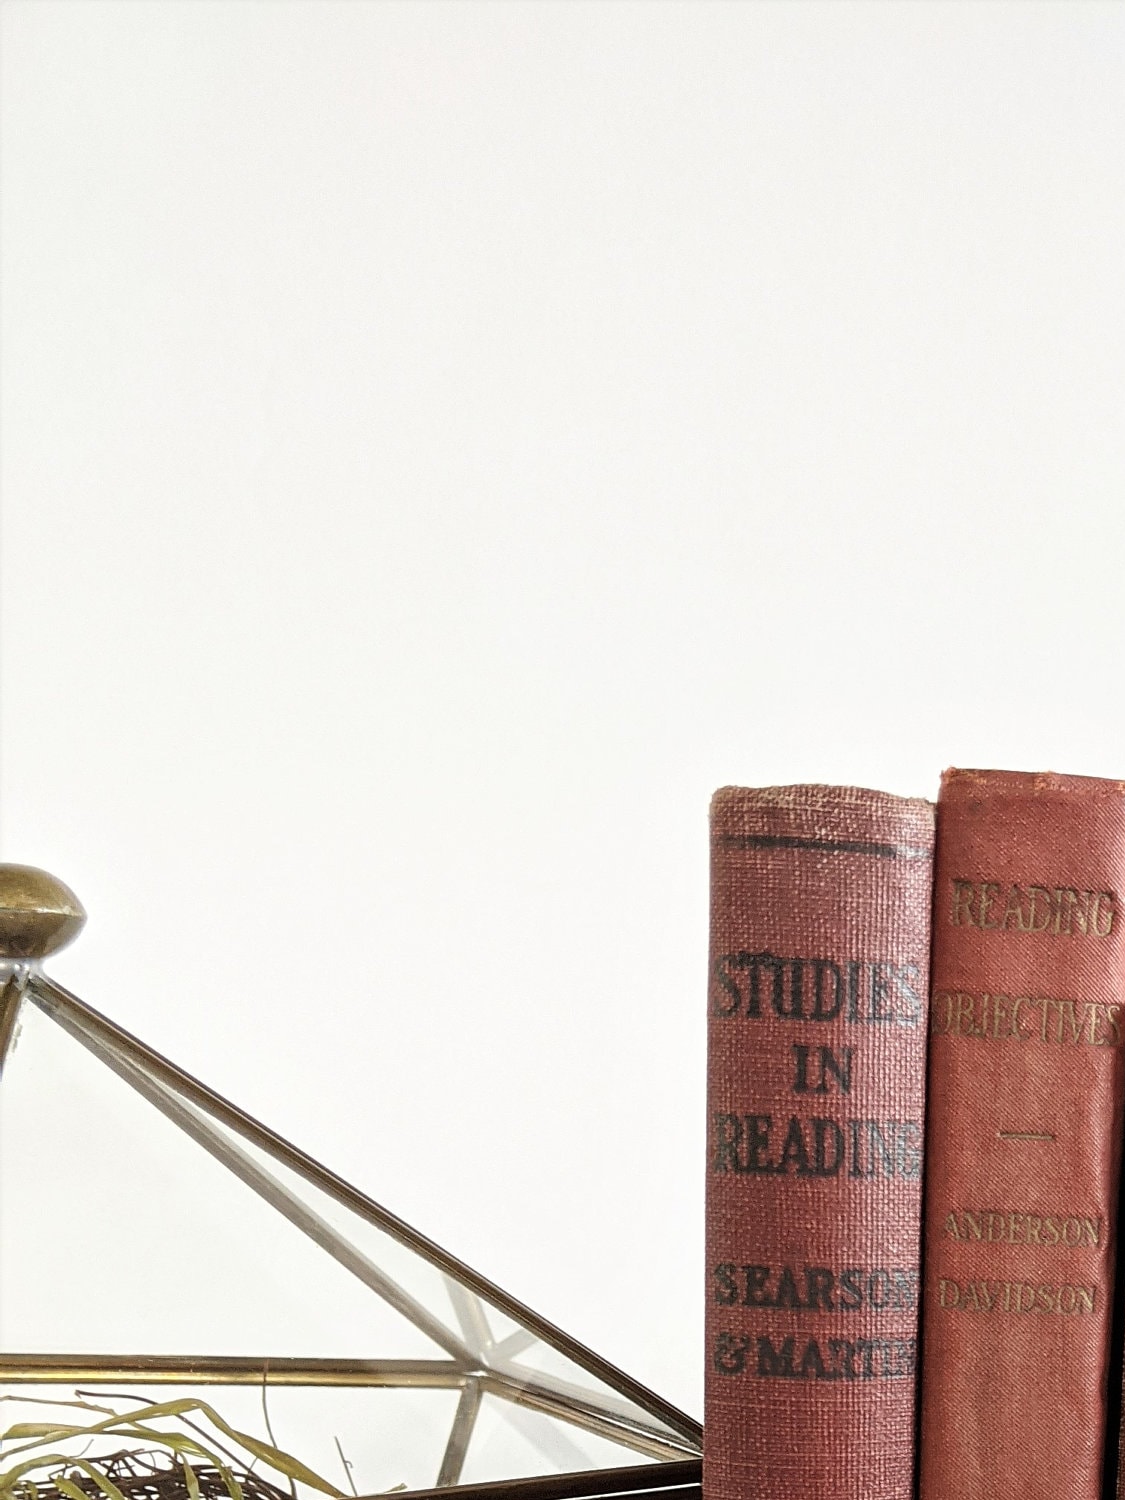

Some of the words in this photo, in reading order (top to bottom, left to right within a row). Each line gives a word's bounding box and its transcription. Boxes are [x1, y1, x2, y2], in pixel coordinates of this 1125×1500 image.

[951, 878, 1117, 938] READING
[712, 951, 922, 1027] STUDIES
[932, 989, 1122, 1047] OBJECTIVES
[791, 1043, 855, 1095] IN
[713, 1112, 920, 1181] READING
[943, 1210, 1102, 1249] ANDERSON
[714, 1262, 920, 1312] SEARSON
[938, 1277, 1098, 1316] DAVIDSON
